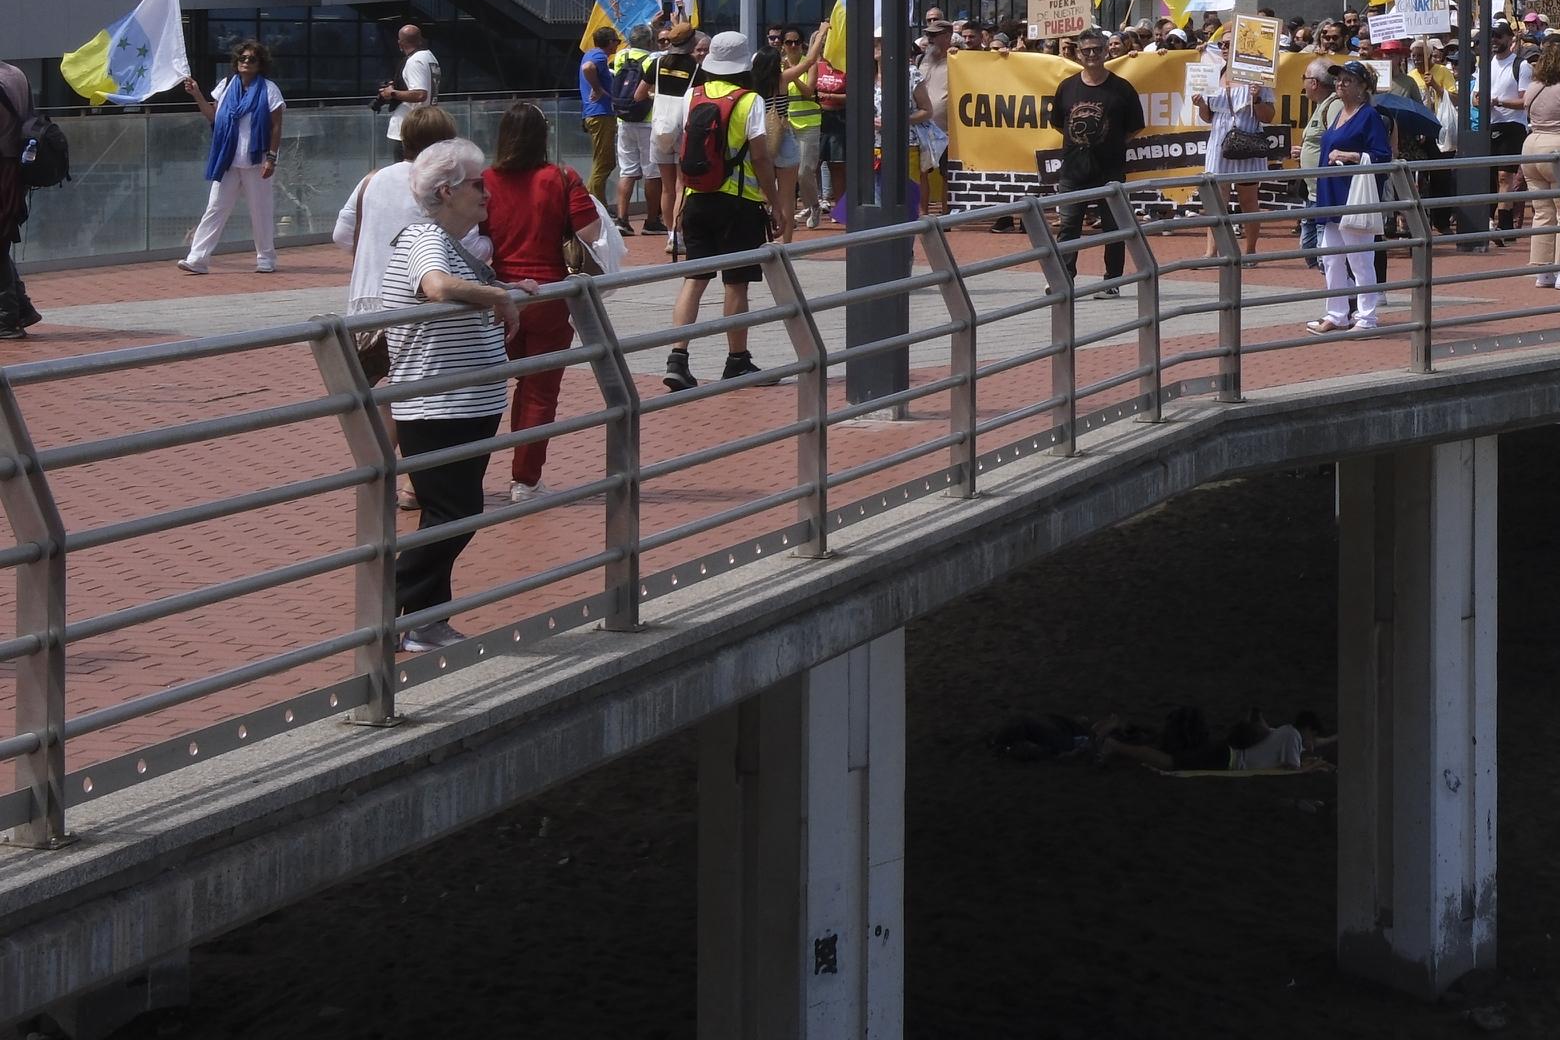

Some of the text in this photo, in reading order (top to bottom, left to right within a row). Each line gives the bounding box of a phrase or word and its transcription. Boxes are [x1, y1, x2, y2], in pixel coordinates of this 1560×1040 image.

[1044, 17, 1084, 35] PUEBLO
[959, 93, 1056, 128] CANAR
[1281, 87, 1318, 128] LÍ
[1045, 159, 1064, 173] ¡P
[1126, 142, 1184, 162] AMBIO
